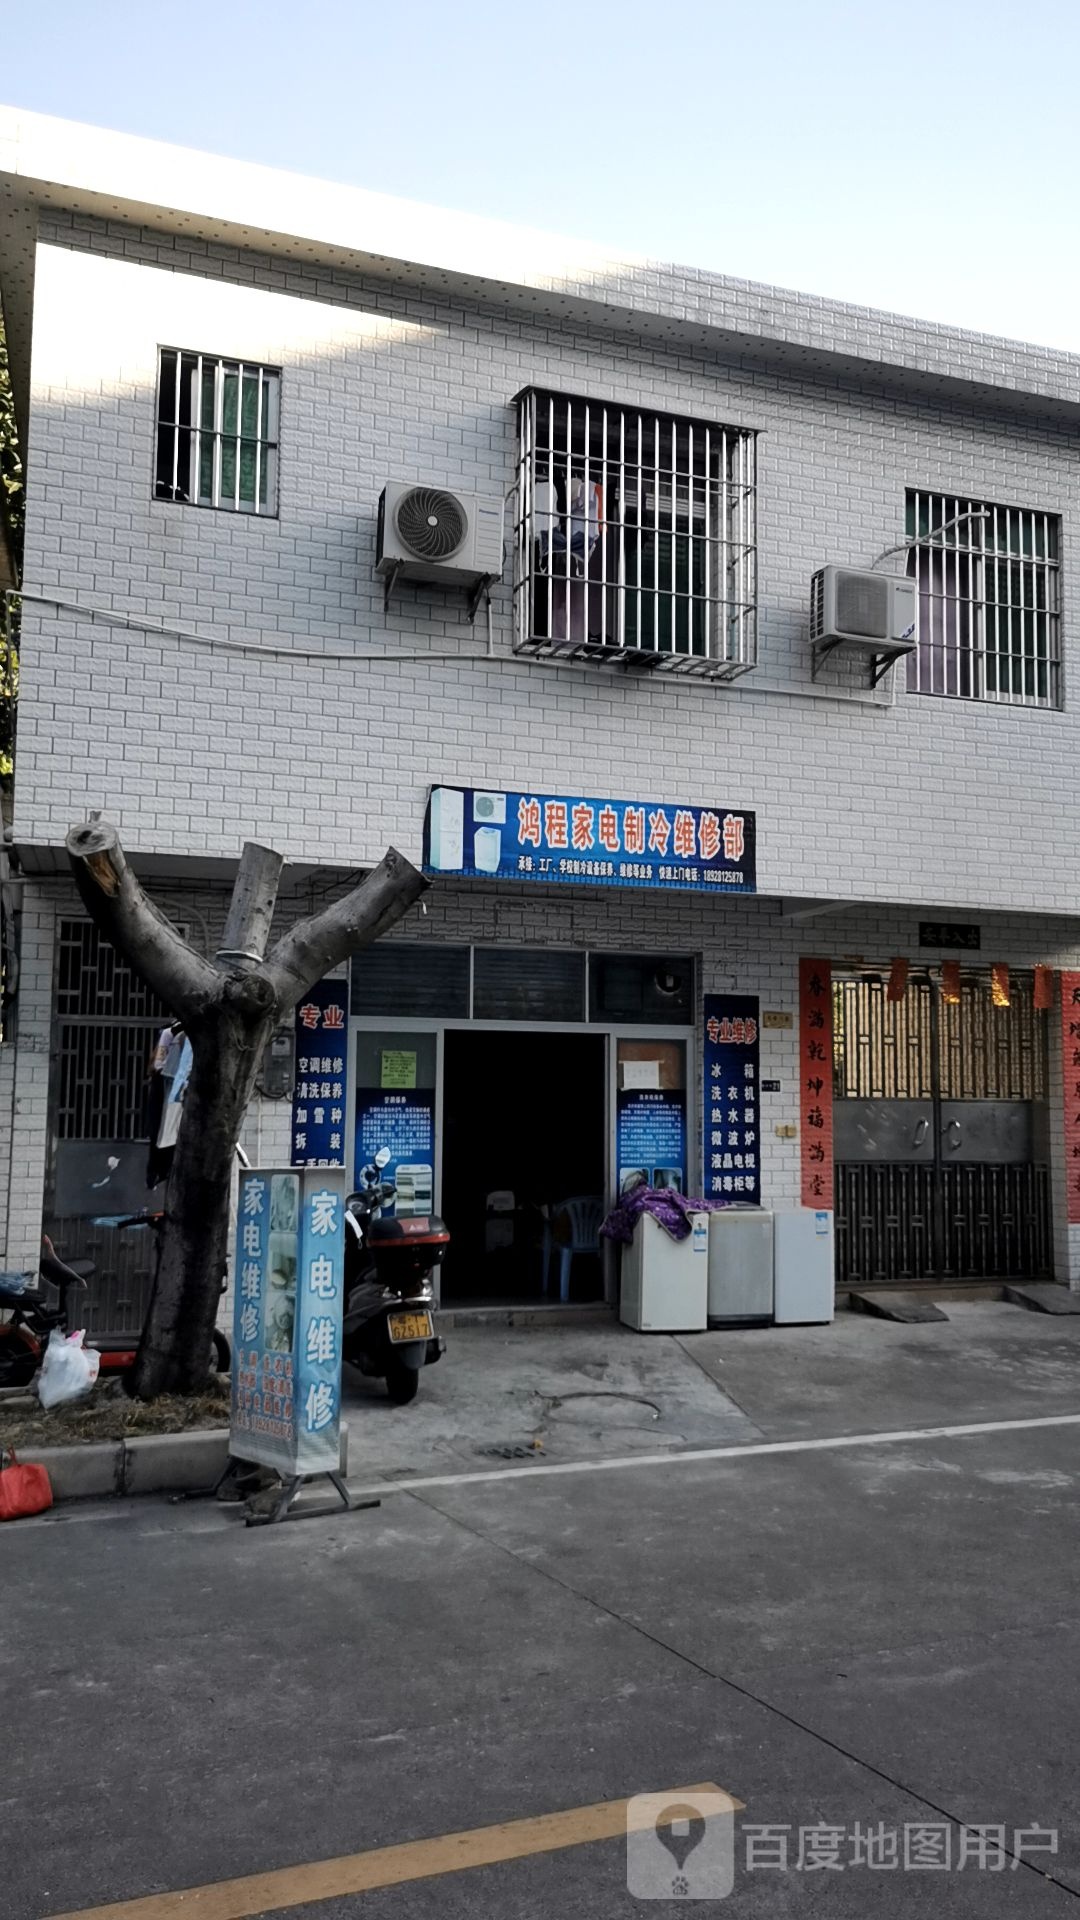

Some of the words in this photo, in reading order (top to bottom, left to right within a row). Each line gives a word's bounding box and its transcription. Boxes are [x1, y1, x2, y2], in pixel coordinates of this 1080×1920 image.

[517, 797, 745, 861] 鸿程家电制冷维修部
[299, 1003, 345, 1029] 专业
[707, 1016, 758, 1045] 专业维修
[298, 1056, 344, 1074] 空调维修
[710, 1062, 755, 1080] 冰箱
[296, 1081, 343, 1099] 清洗保养
[710, 1085, 756, 1102] 洗衣机
[710, 1107, 755, 1124] 热水器
[295, 1132, 341, 1150] 拆装
[710, 1130, 756, 1147] 微波炉
[710, 1153, 756, 1169] 液晶电视
[710, 1175, 756, 1193] 消毒柜等
[239, 1177, 265, 1343] 家电维修
[305, 1189, 338, 1432] 家电维修
